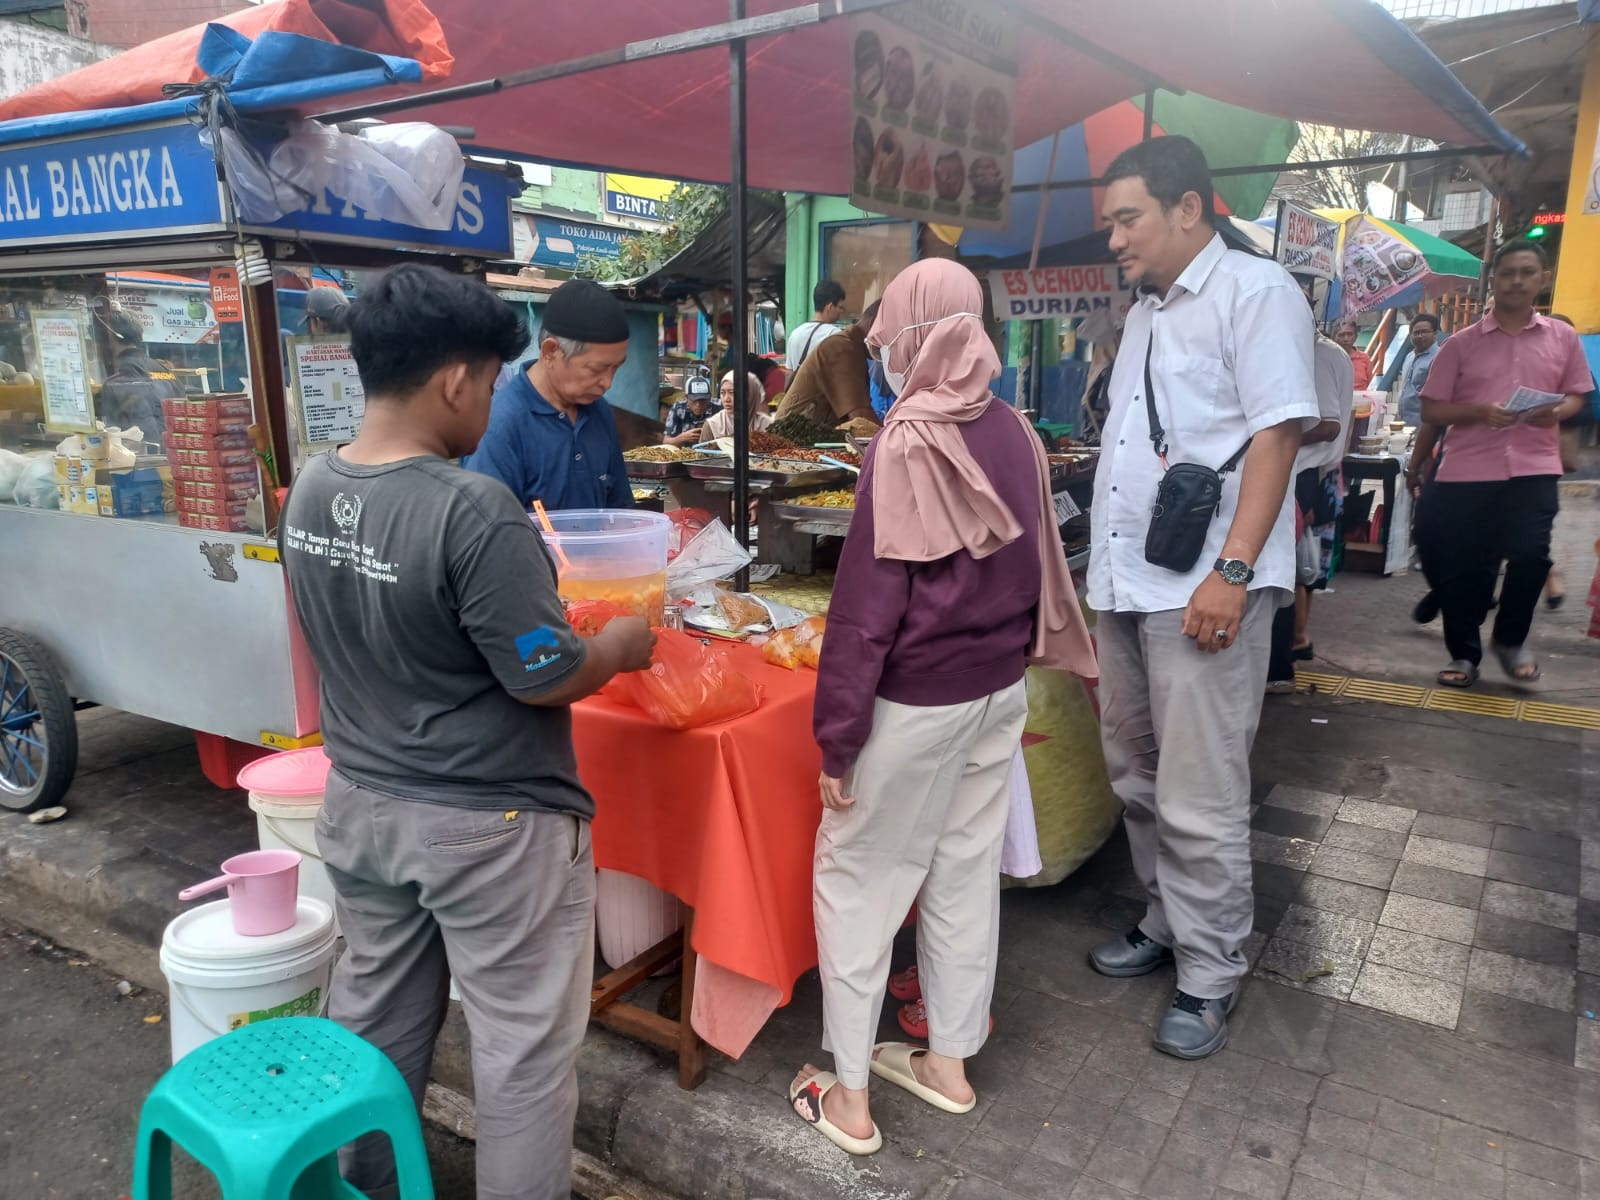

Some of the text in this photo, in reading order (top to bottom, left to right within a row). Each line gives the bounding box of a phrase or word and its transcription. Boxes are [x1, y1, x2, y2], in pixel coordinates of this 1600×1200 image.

[46, 146, 183, 218] BANGKA
[560, 224, 587, 238] TOKO
[589, 229, 611, 242] AIDA
[1003, 270, 1028, 295] ES
[1032, 267, 1112, 294] CENDOL
[223, 293, 239, 301] Food
[166, 306, 184, 316] Jual
[1010, 296, 1112, 316] DURIAN
[300, 353, 353, 362] SPESIAL BANGK
[307, 533, 330, 546] Tanpa
[332, 537, 350, 549] Guru
